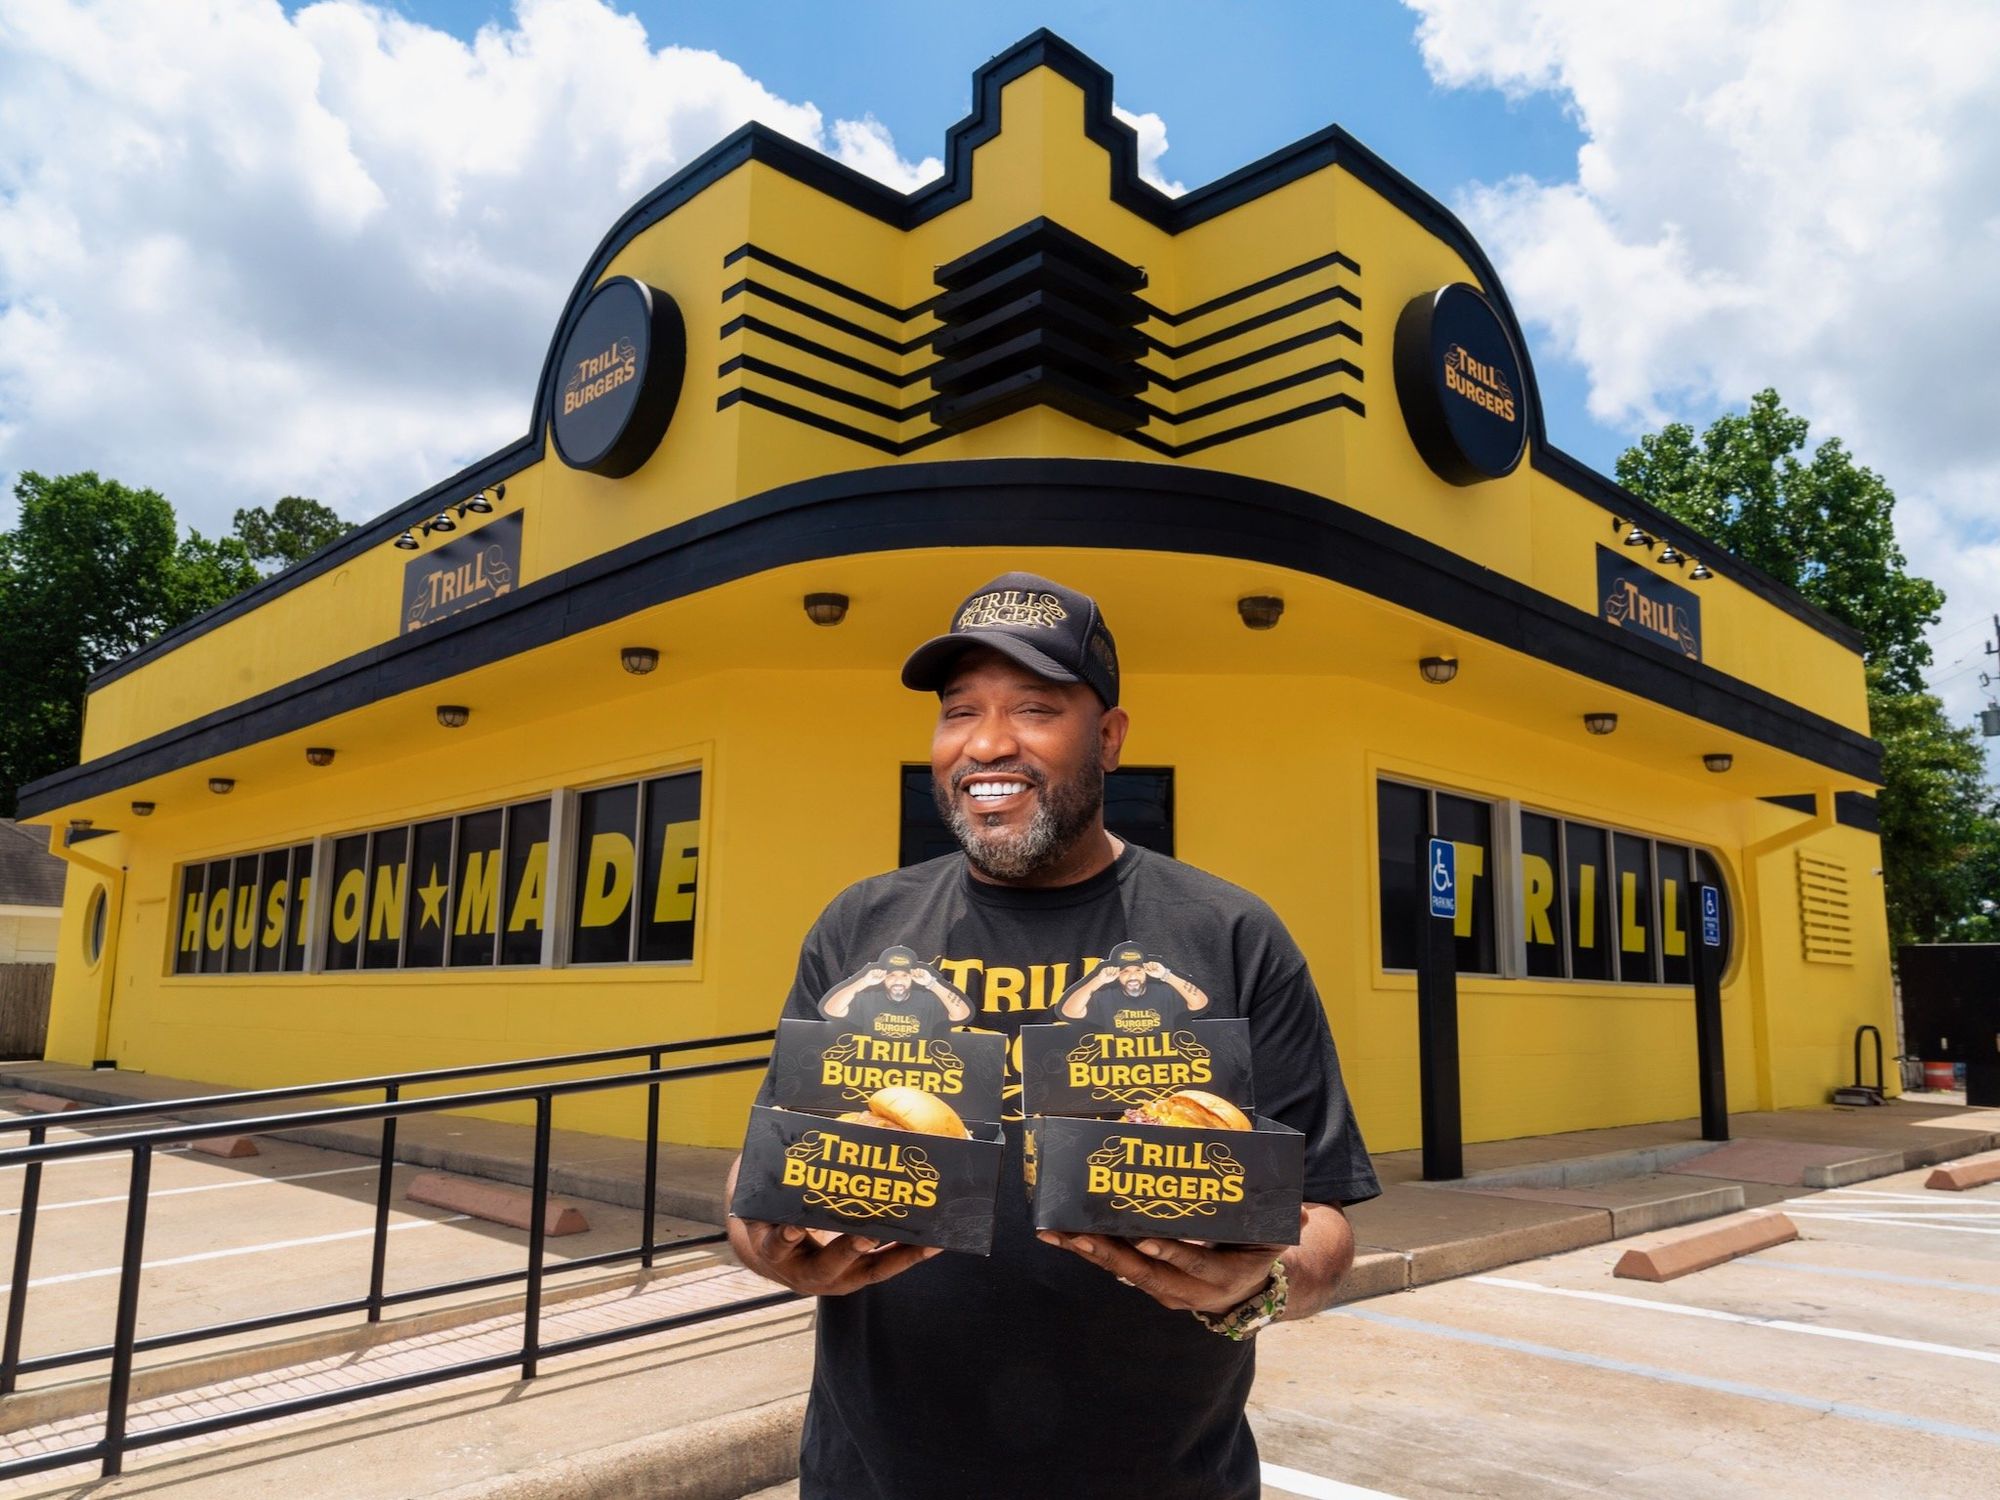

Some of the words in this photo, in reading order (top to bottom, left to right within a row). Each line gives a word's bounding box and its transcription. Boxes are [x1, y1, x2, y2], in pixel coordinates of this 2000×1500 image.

[579, 343, 620, 383] TRILL
[1456, 346, 1499, 390] TRILL
[564, 356, 636, 416] BURGERS
[1445, 364, 1516, 422] BURGERS
[428, 551, 488, 609] TRILL
[1624, 581, 1680, 641] TRILL
[455, 820, 700, 937] MADE
[1452, 841, 1686, 957] TRILL
[874, 1020, 920, 1034] BURGERS
[884, 1012, 911, 1024] TRILL
[1115, 1018, 1161, 1029] BURGERS
[1124, 1009, 1151, 1019] TRILL
[851, 1035, 934, 1065] TRILL
[1094, 1032, 1179, 1059] TRILL
[821, 1060, 964, 1094] BURGERS
[1068, 1059, 1213, 1088] BURGERS
[818, 1132, 906, 1173] TRILL
[1120, 1137, 1211, 1171] TRILL
[782, 1157, 939, 1208] BURGERS
[1087, 1165, 1245, 1204] BURGERS
